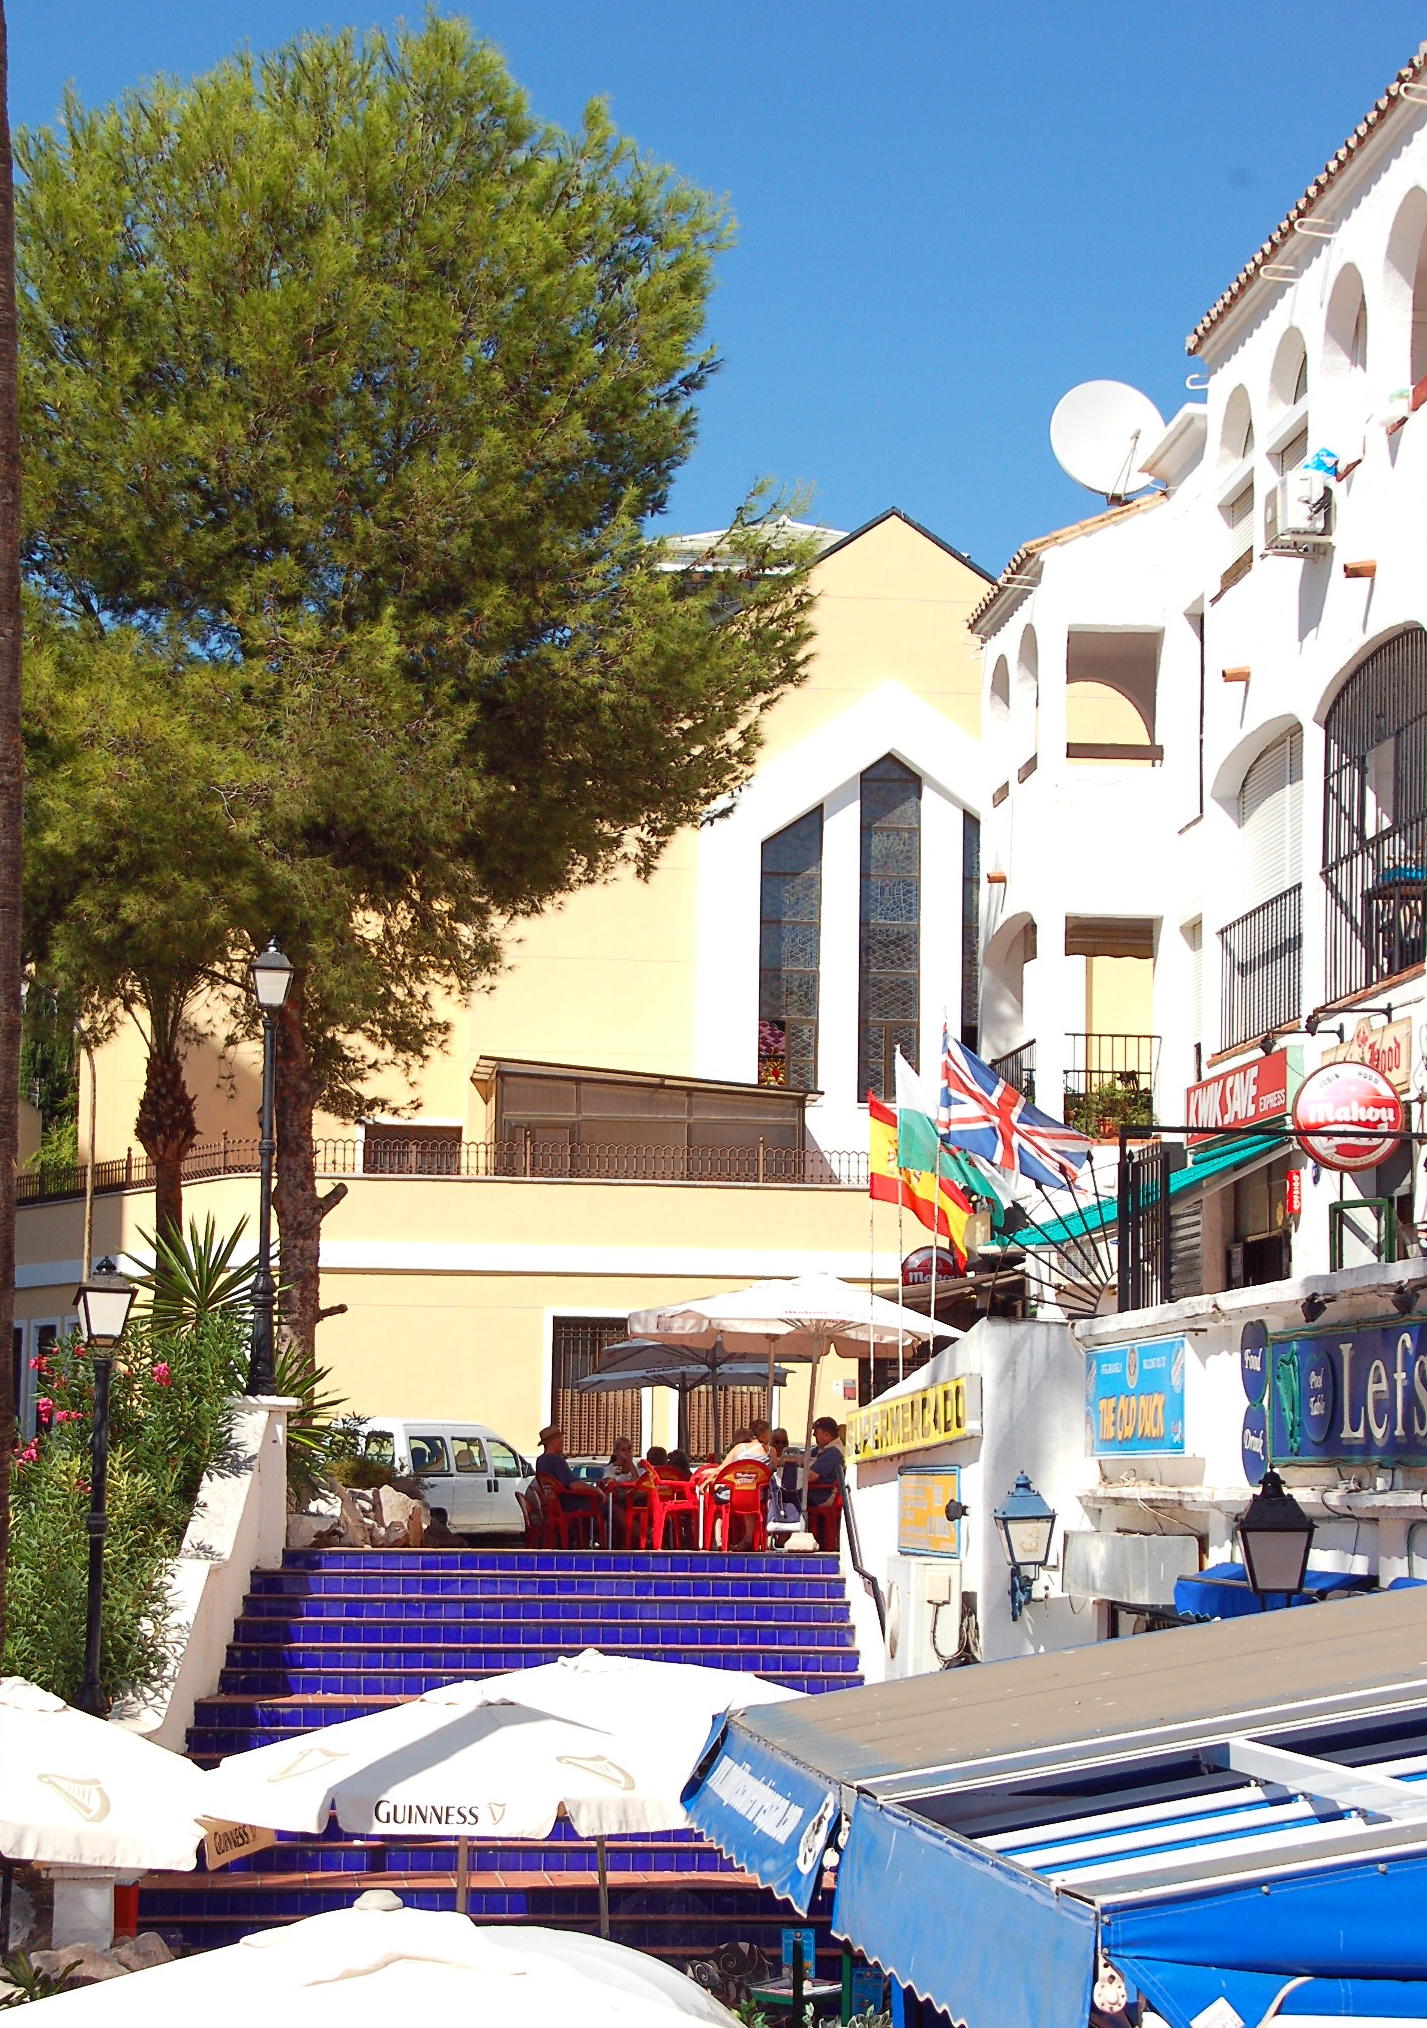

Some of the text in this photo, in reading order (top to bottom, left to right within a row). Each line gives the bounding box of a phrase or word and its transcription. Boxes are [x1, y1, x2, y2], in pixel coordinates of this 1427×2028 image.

[1188, 1065, 1259, 1138] KWIK SAVE
[1260, 1088, 1285, 1112] EXPRESS
[1307, 1102, 1395, 1123] Mahou
[847, 1385, 965, 1457] SUPERMERCADO
[1099, 1391, 1165, 1442] THE OLD DUCK
[374, 1800, 479, 1825] GUINNESS
[214, 1825, 248, 1855] GUINNESS
